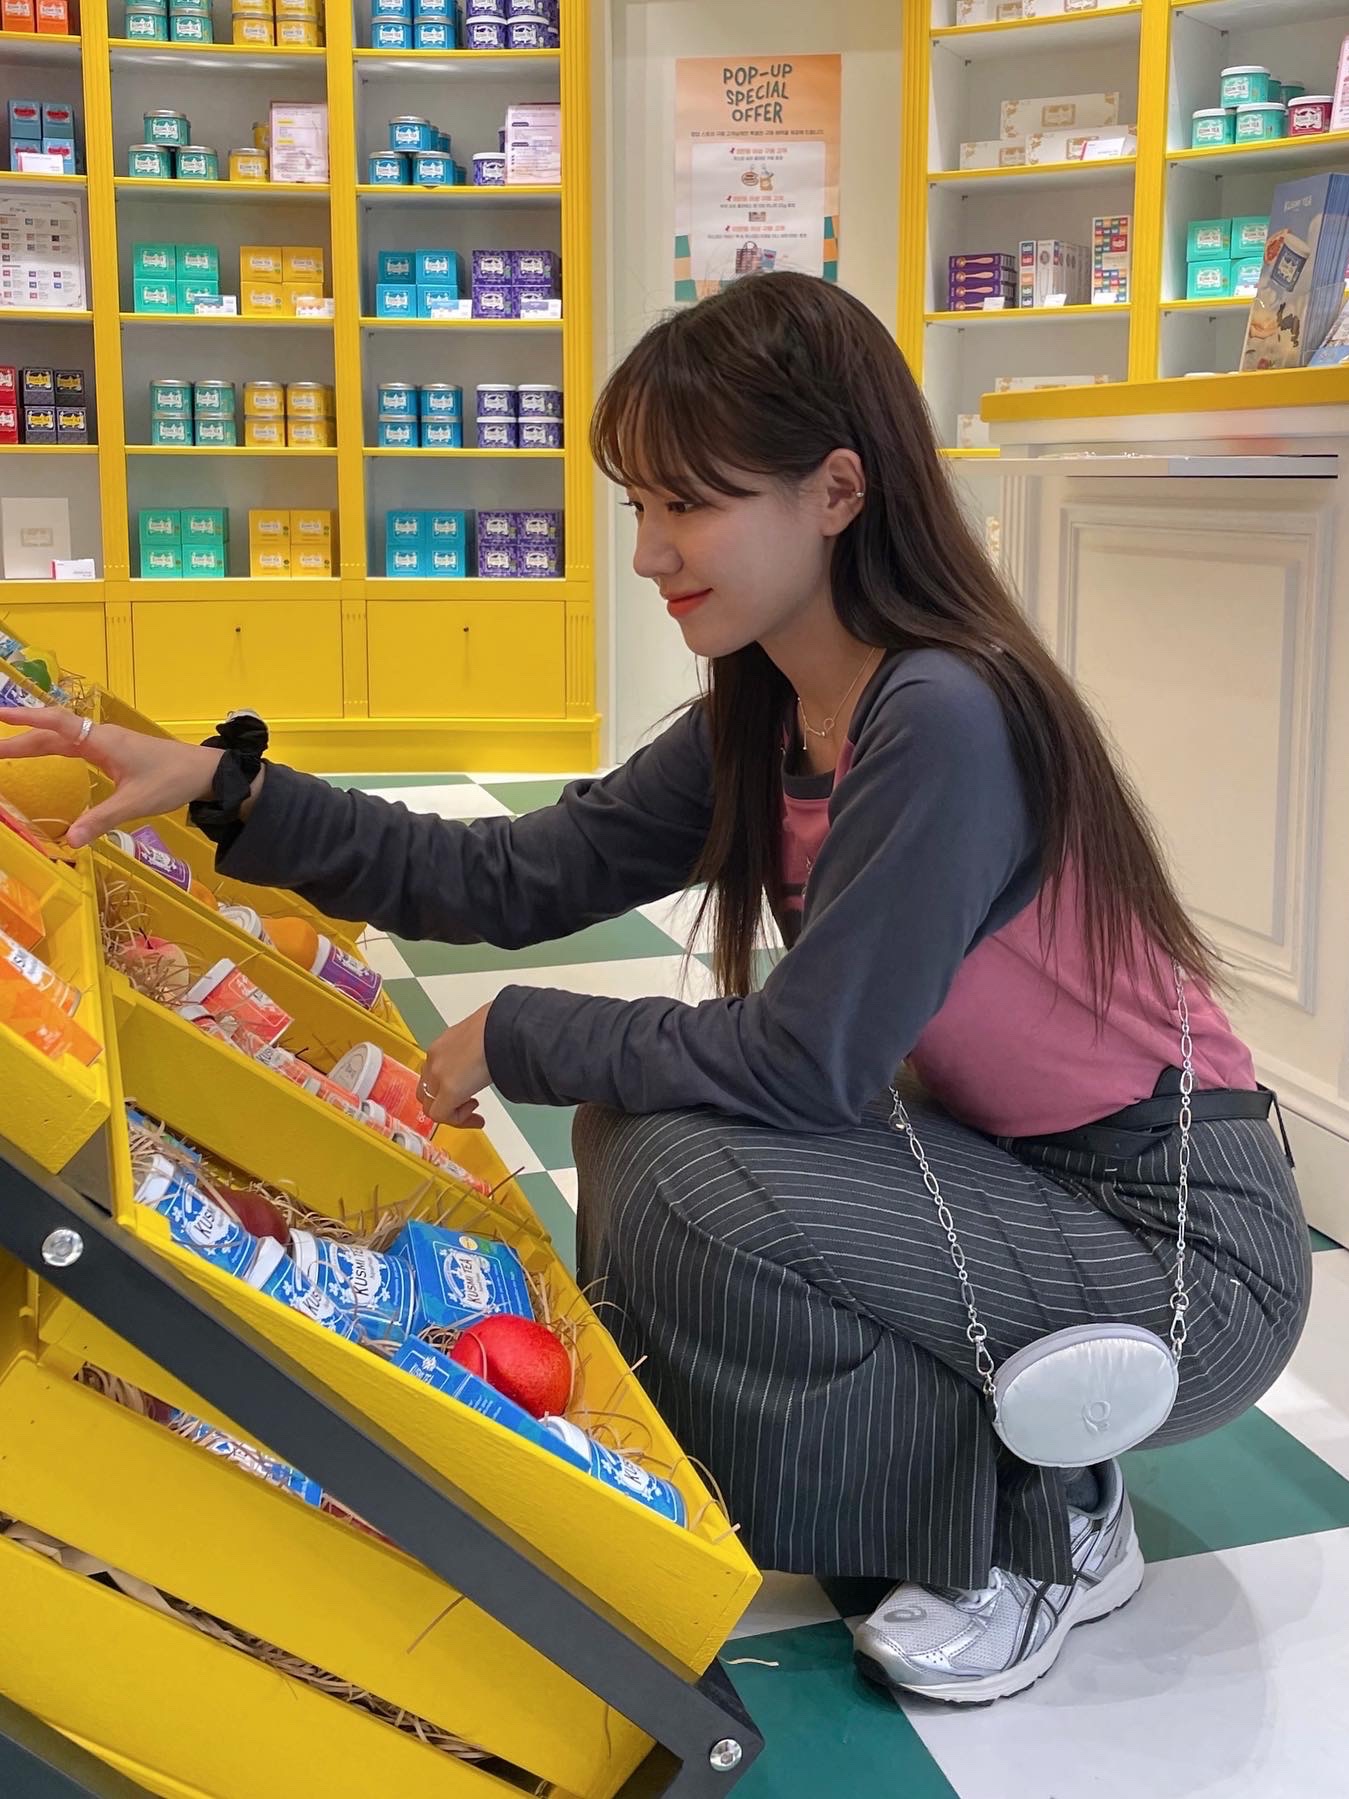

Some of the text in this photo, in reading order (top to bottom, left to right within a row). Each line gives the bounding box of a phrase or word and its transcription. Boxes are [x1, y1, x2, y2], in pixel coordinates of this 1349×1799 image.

[723, 63, 793, 86] POP-UP
[726, 81, 789, 106] SPECIAL
[732, 101, 783, 123] OFFER
[459, 1258, 473, 1275] TEA
